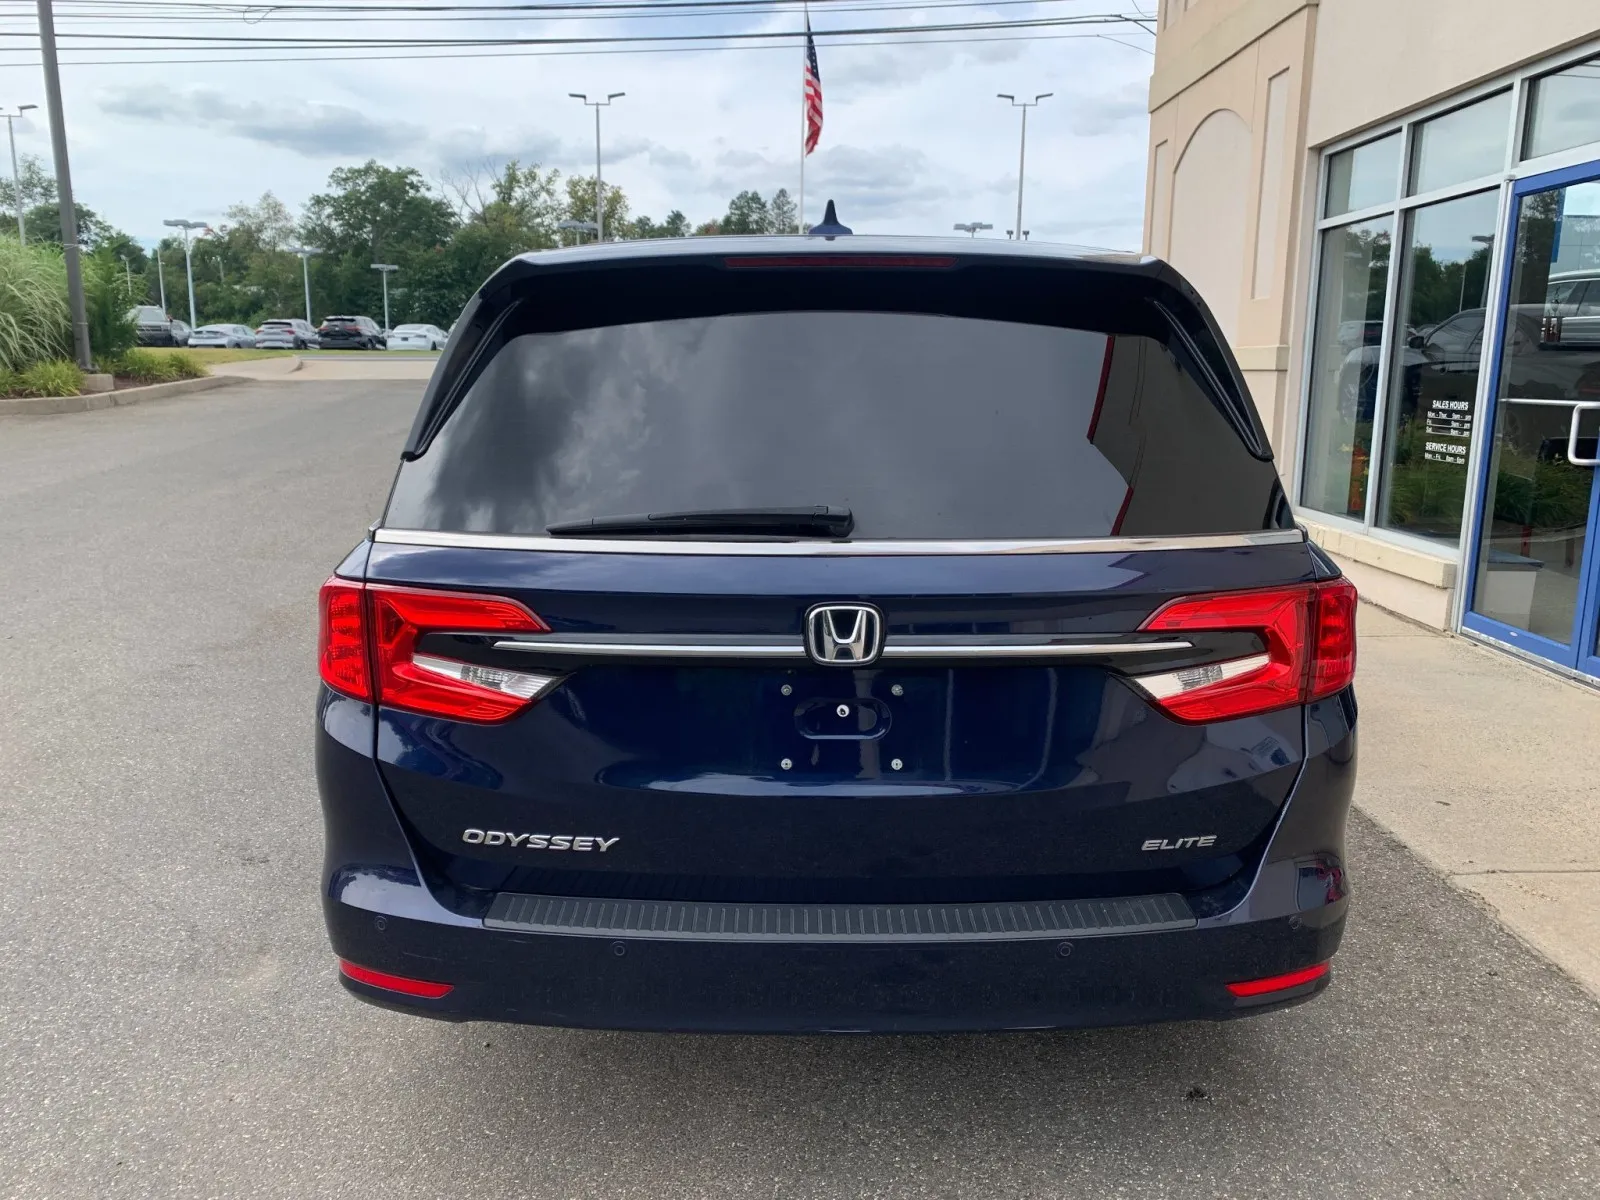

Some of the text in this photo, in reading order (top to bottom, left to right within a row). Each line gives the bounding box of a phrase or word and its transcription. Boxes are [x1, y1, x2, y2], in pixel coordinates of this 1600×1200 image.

[1432, 400, 1469, 410] SALES HOURS
[1425, 442, 1467, 455] SERVICE HOURS
[462, 829, 620, 852] ODYSSEY
[1141, 835, 1218, 851] ELITE
